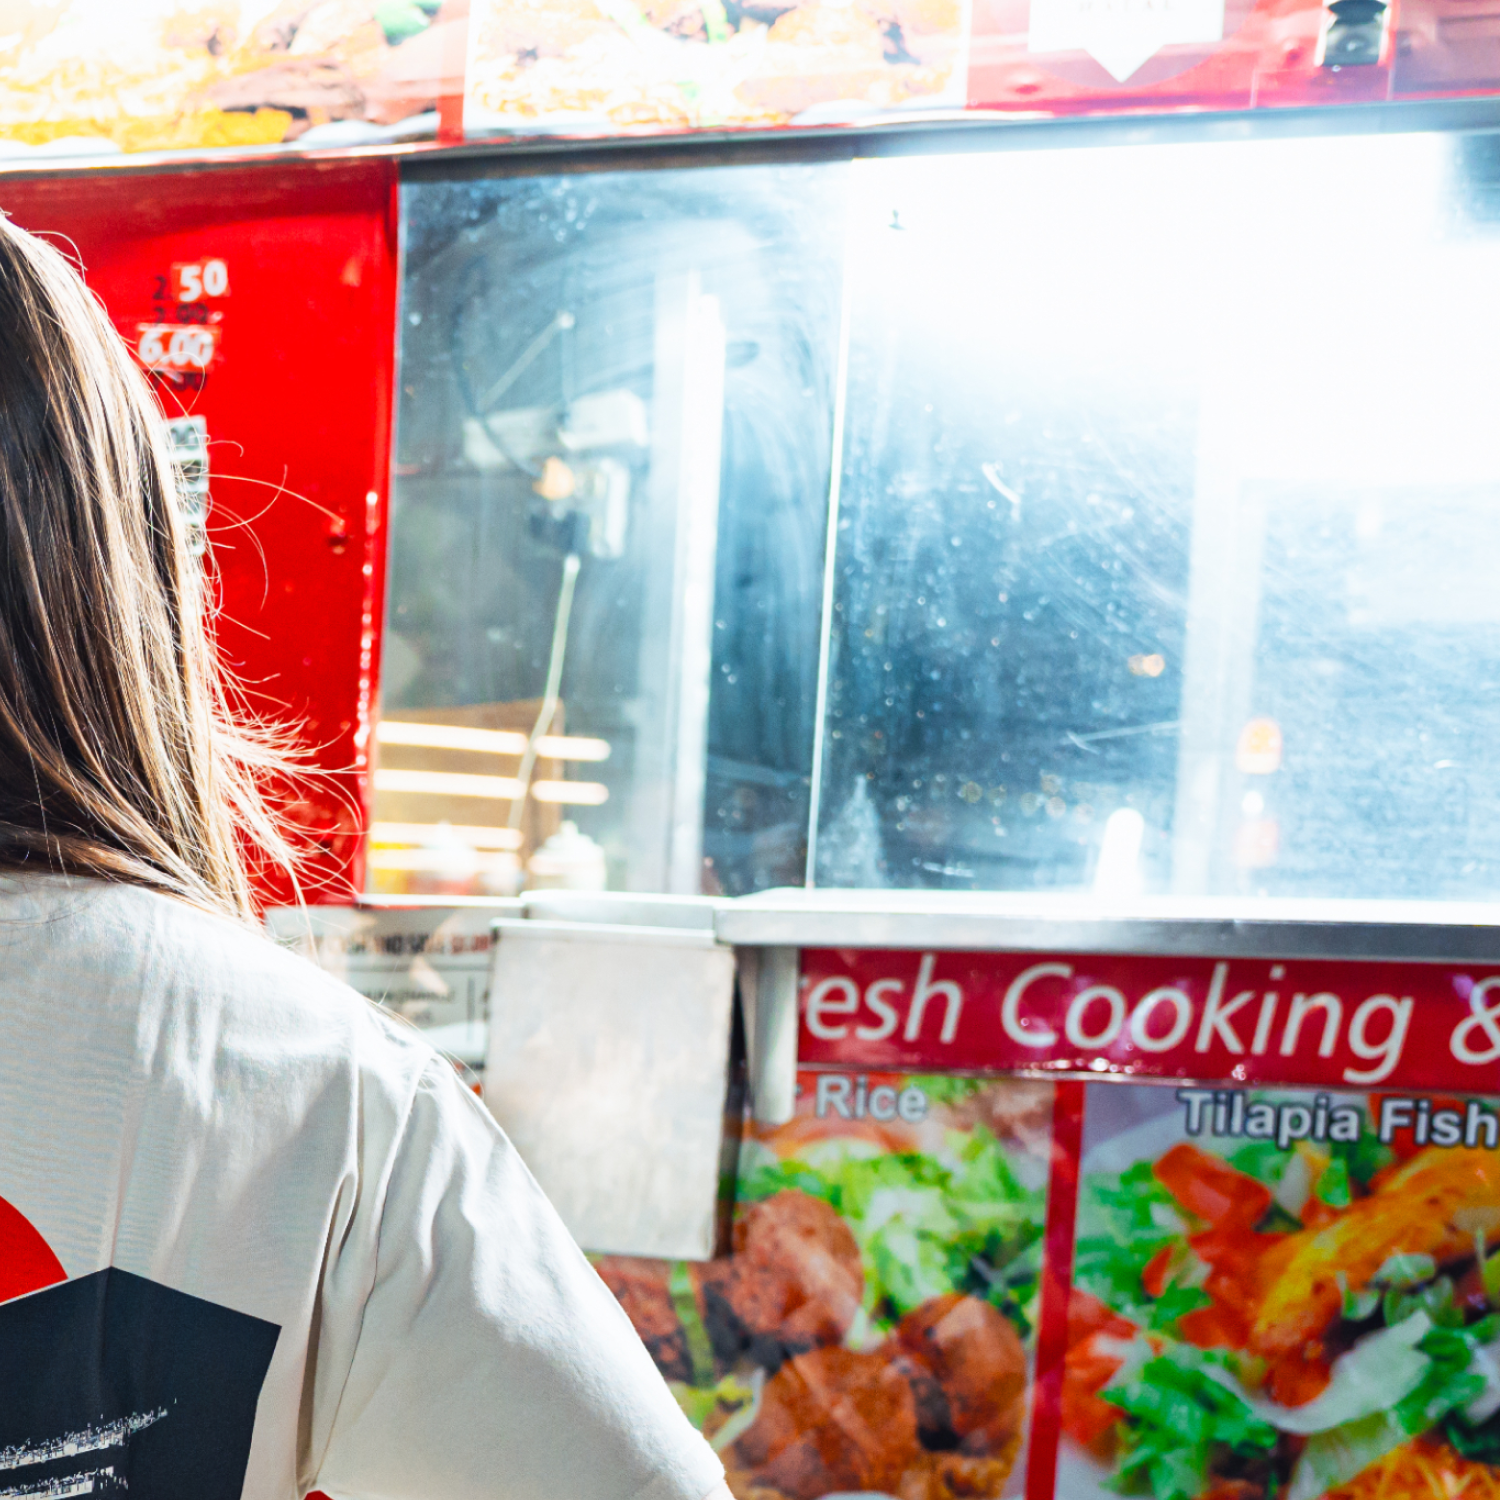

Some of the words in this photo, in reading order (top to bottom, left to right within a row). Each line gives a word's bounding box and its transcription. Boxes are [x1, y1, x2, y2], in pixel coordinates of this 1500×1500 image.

[139, 329, 214, 367] 6.00
[802, 953, 963, 1043] esh
[1001, 962, 1414, 1084] Cooking
[816, 1075, 927, 1123] Rice
[1178, 1089, 1360, 1149] Tilapia
[1380, 1098, 1499, 1148] Fish
